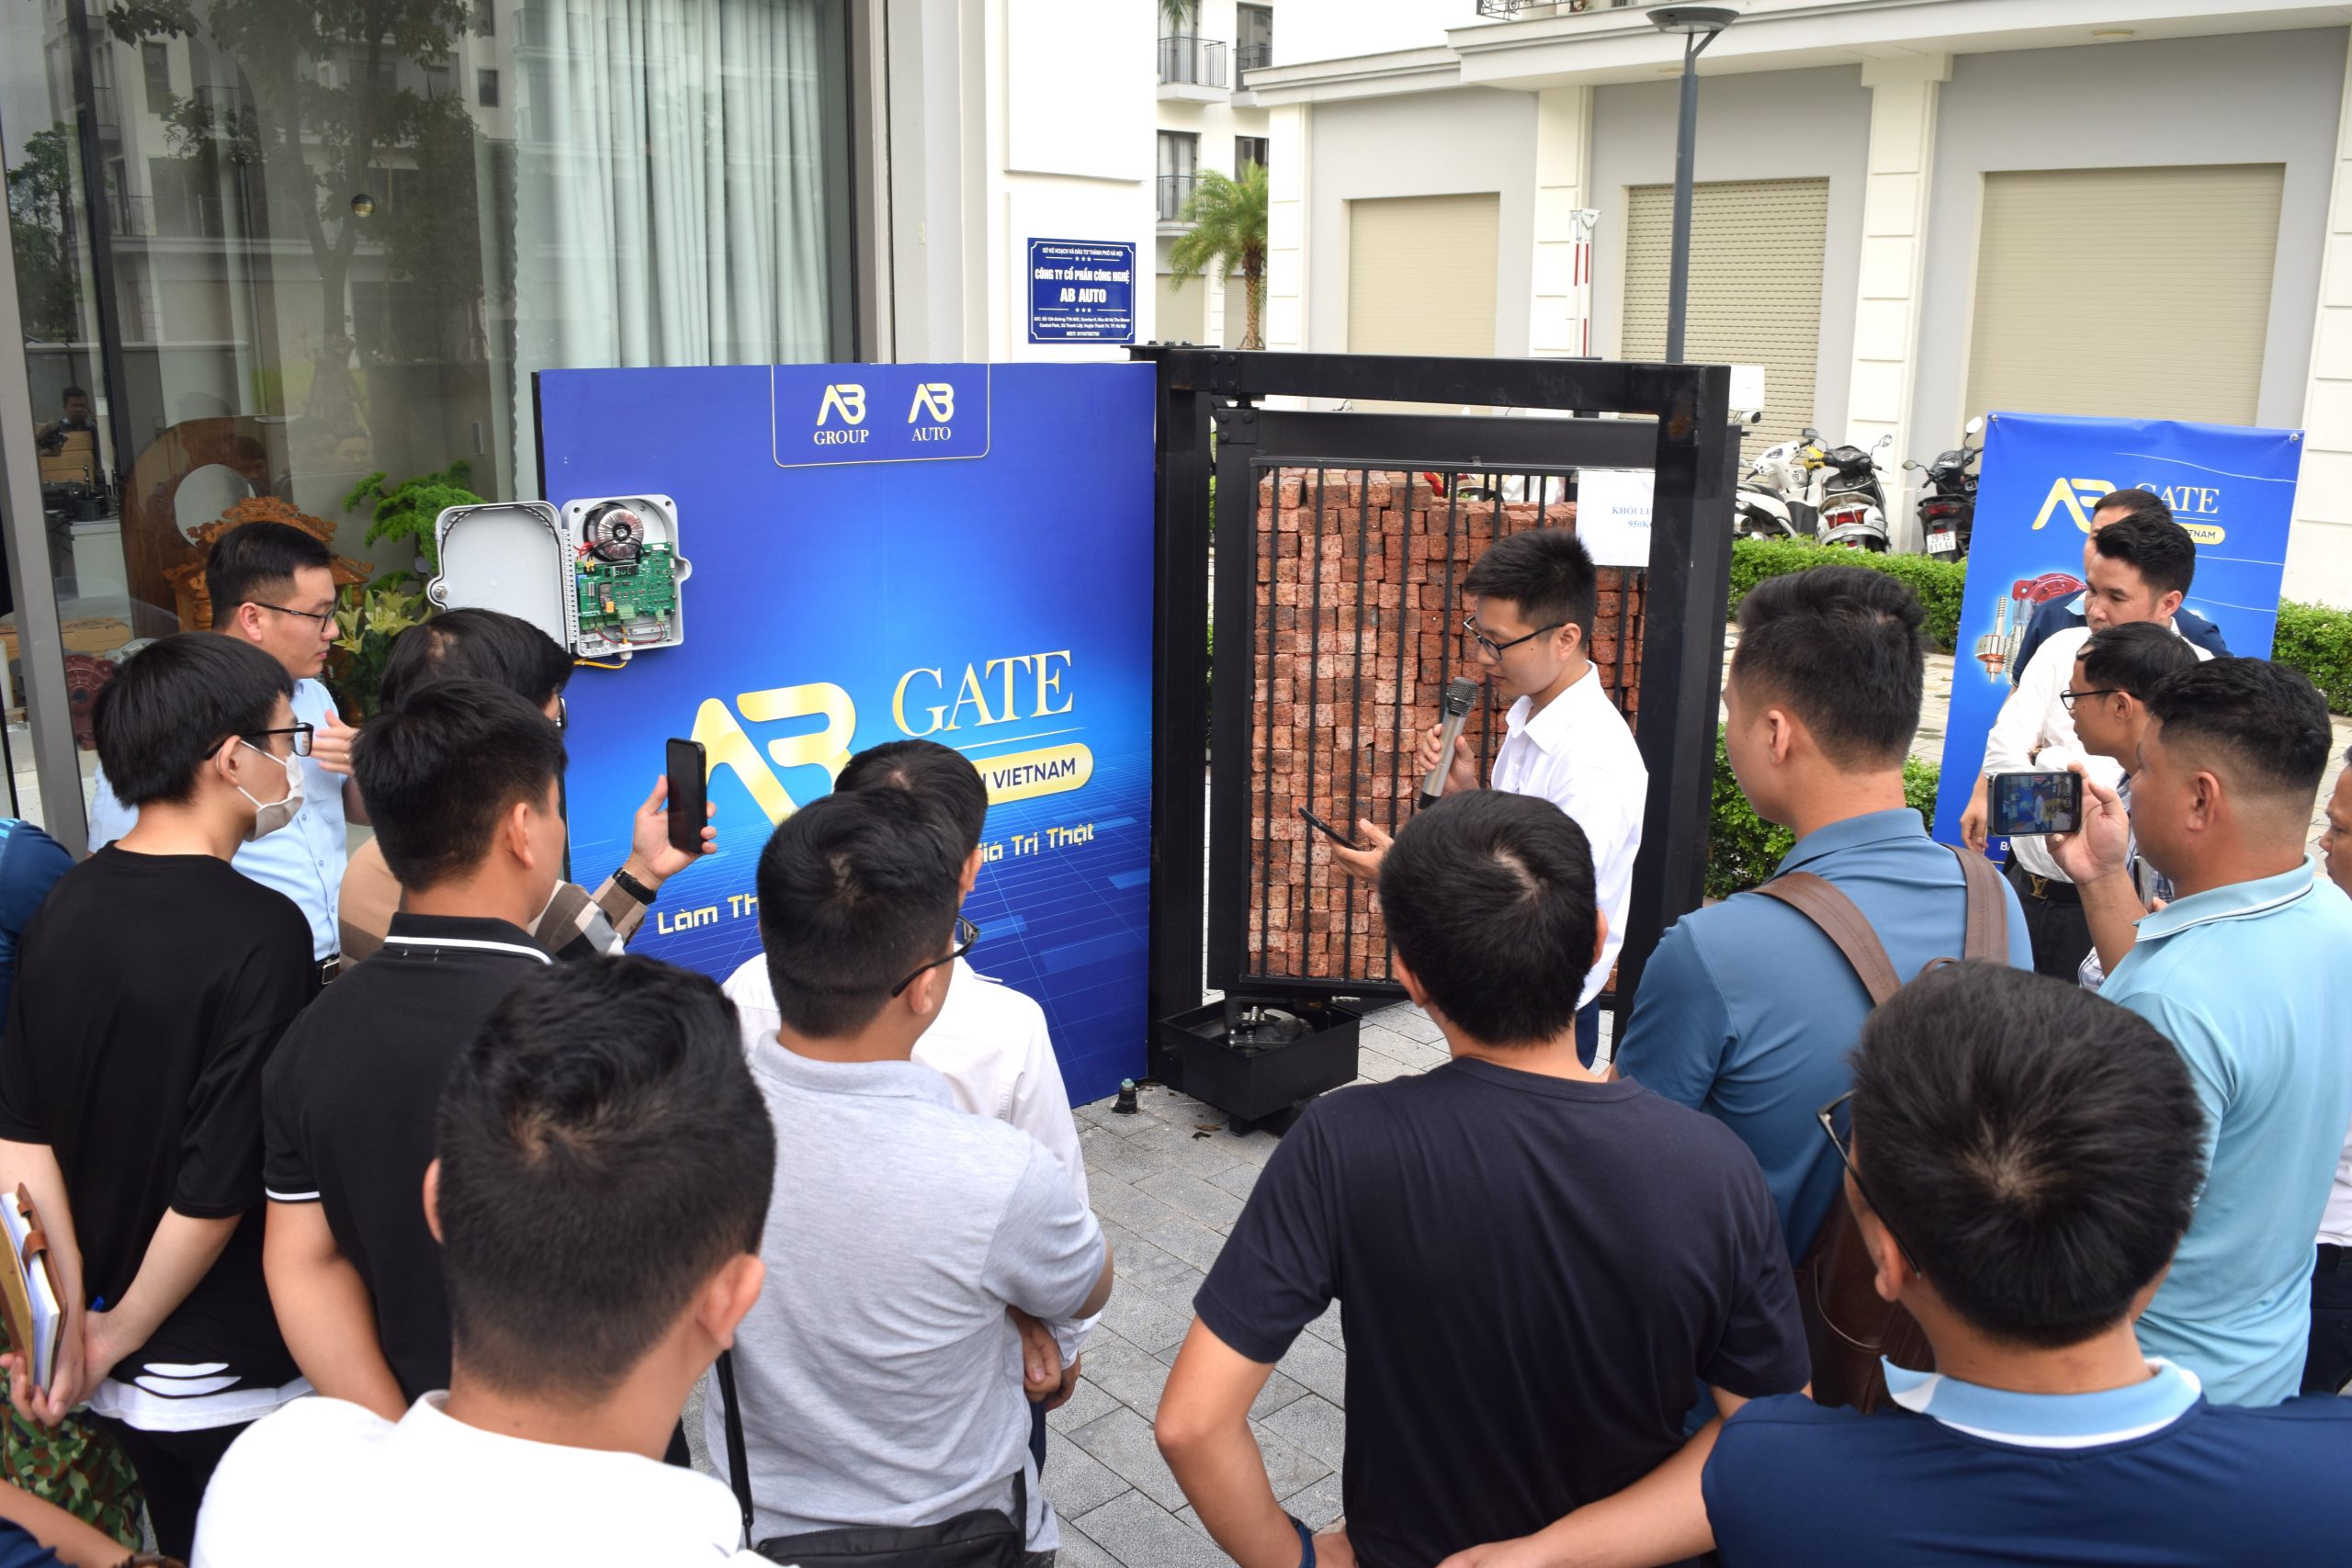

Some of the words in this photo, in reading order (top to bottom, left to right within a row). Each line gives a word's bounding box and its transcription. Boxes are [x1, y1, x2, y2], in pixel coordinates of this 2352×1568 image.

[1035, 266, 1054, 279] CÔNG
[1055, 269, 1063, 280] TY
[1064, 265, 1074, 280] CỔ
[1093, 268, 1112, 282] CÔNG
[1112, 269, 1130, 285] NGHỆ
[1059, 288, 1076, 302] AB
[1078, 288, 1106, 303] AUTO
[816, 384, 866, 426] AB
[908, 383, 955, 423] AB
[813, 429, 869, 446] GROUP
[911, 426, 952, 442] AUTO
[892, 649, 1074, 738] GATE
[992, 757, 1077, 789] VIETNAM
[657, 906, 718, 935] Làm
[978, 840, 1003, 863] iá
[1011, 831, 1039, 856] Trị
[1046, 823, 1094, 849] Thật
